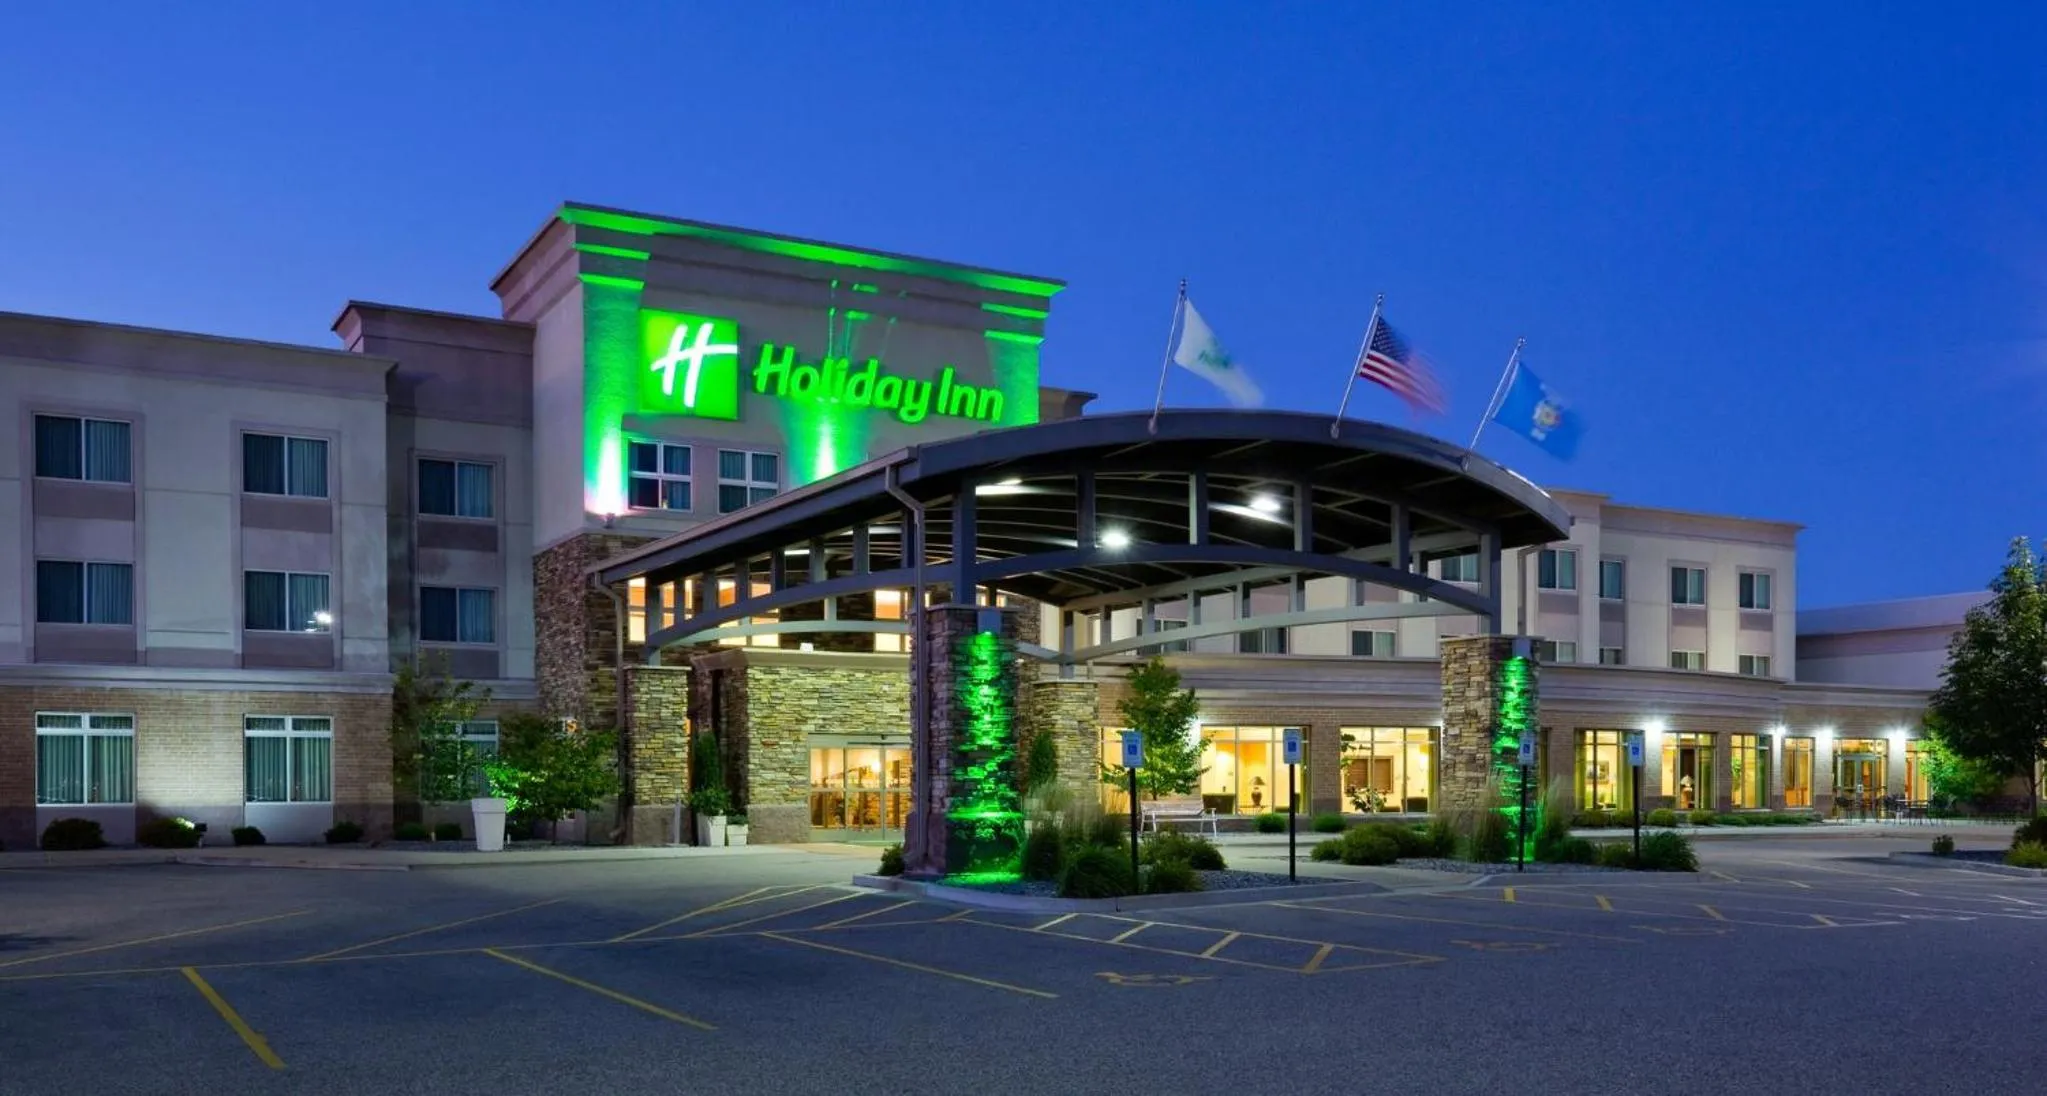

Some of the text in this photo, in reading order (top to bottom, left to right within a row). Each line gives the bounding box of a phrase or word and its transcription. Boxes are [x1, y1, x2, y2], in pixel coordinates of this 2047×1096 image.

[650, 323, 737, 408] H
[753, 343, 1004, 423] Holiday Inn
